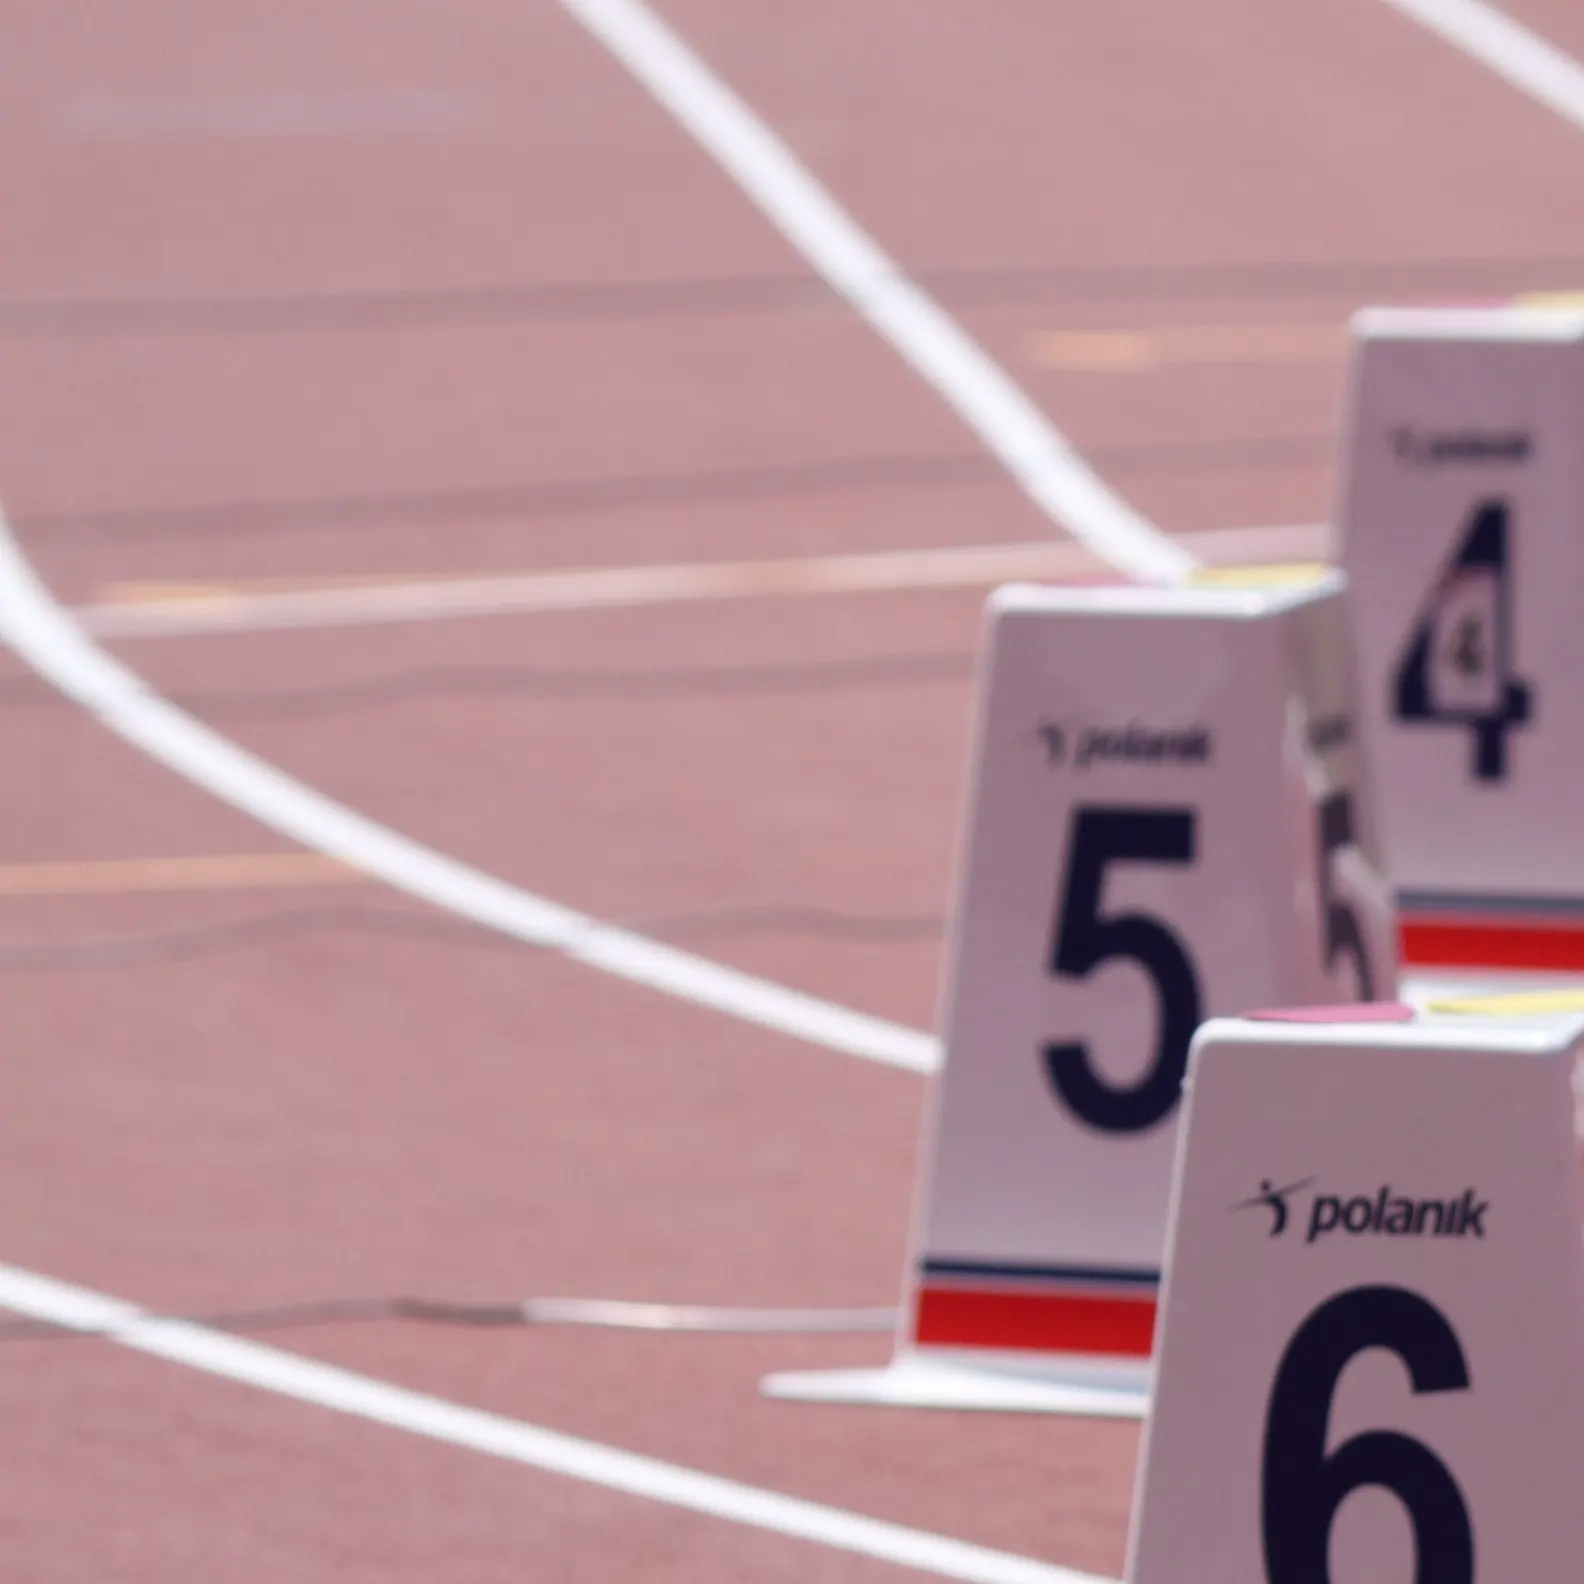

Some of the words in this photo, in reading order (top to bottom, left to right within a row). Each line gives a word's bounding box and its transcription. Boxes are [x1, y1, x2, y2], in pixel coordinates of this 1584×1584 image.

[1392, 500, 1532, 783] 4
[1042, 804, 1206, 1135] 5
[1305, 1183, 1489, 1244] polanik
